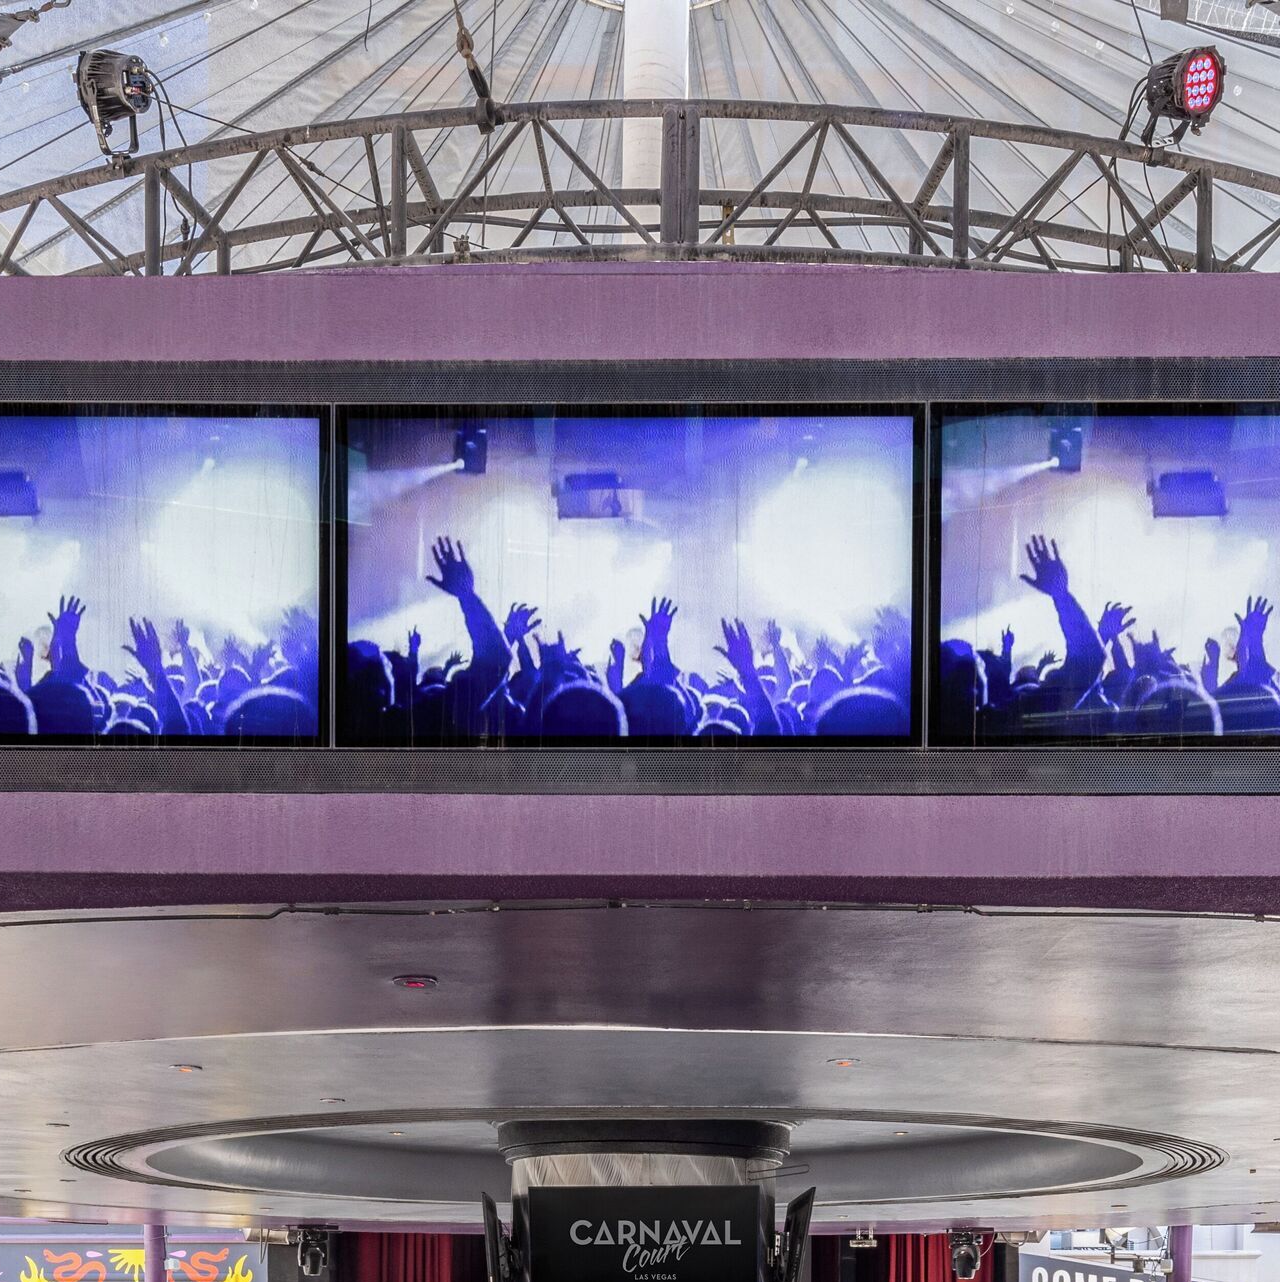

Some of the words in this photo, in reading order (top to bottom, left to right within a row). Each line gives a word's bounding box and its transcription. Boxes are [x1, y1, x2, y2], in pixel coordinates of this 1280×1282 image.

[569, 1219, 742, 1246] CARNAVAL
[622, 1234, 691, 1273] Court
[634, 1273, 649, 1281] LAS
[651, 1273, 677, 1281] VEGAS
